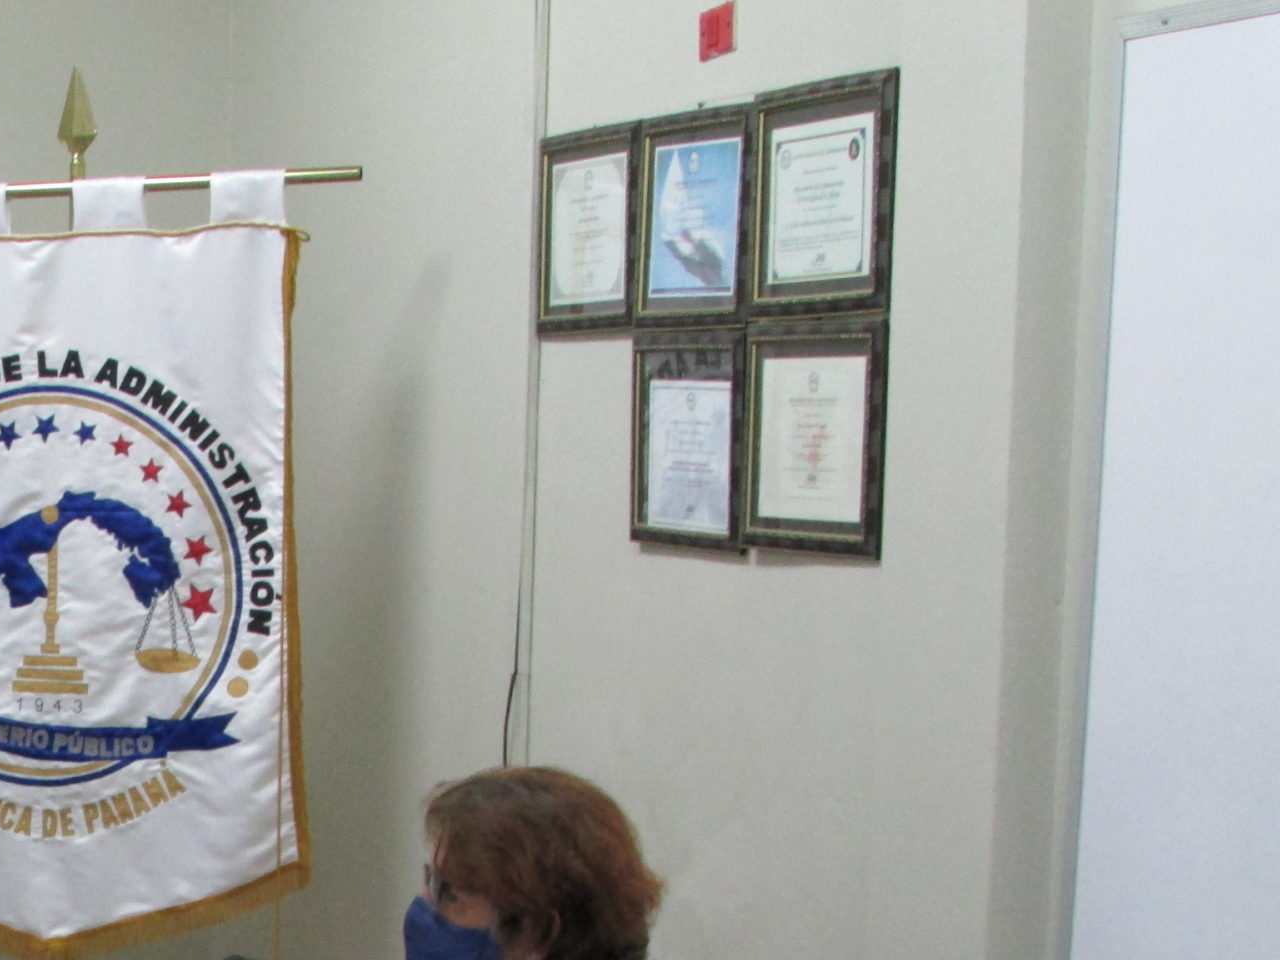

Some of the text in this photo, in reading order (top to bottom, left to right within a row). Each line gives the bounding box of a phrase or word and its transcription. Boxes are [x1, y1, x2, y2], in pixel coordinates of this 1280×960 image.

[37, 349, 84, 378] LA
[94, 357, 282, 636] ADMINISTRACIÓN
[52, 731, 154, 757] PÚBLICO
[42, 808, 75, 838] DE
[83, 760, 187, 834] PANAMÁ
